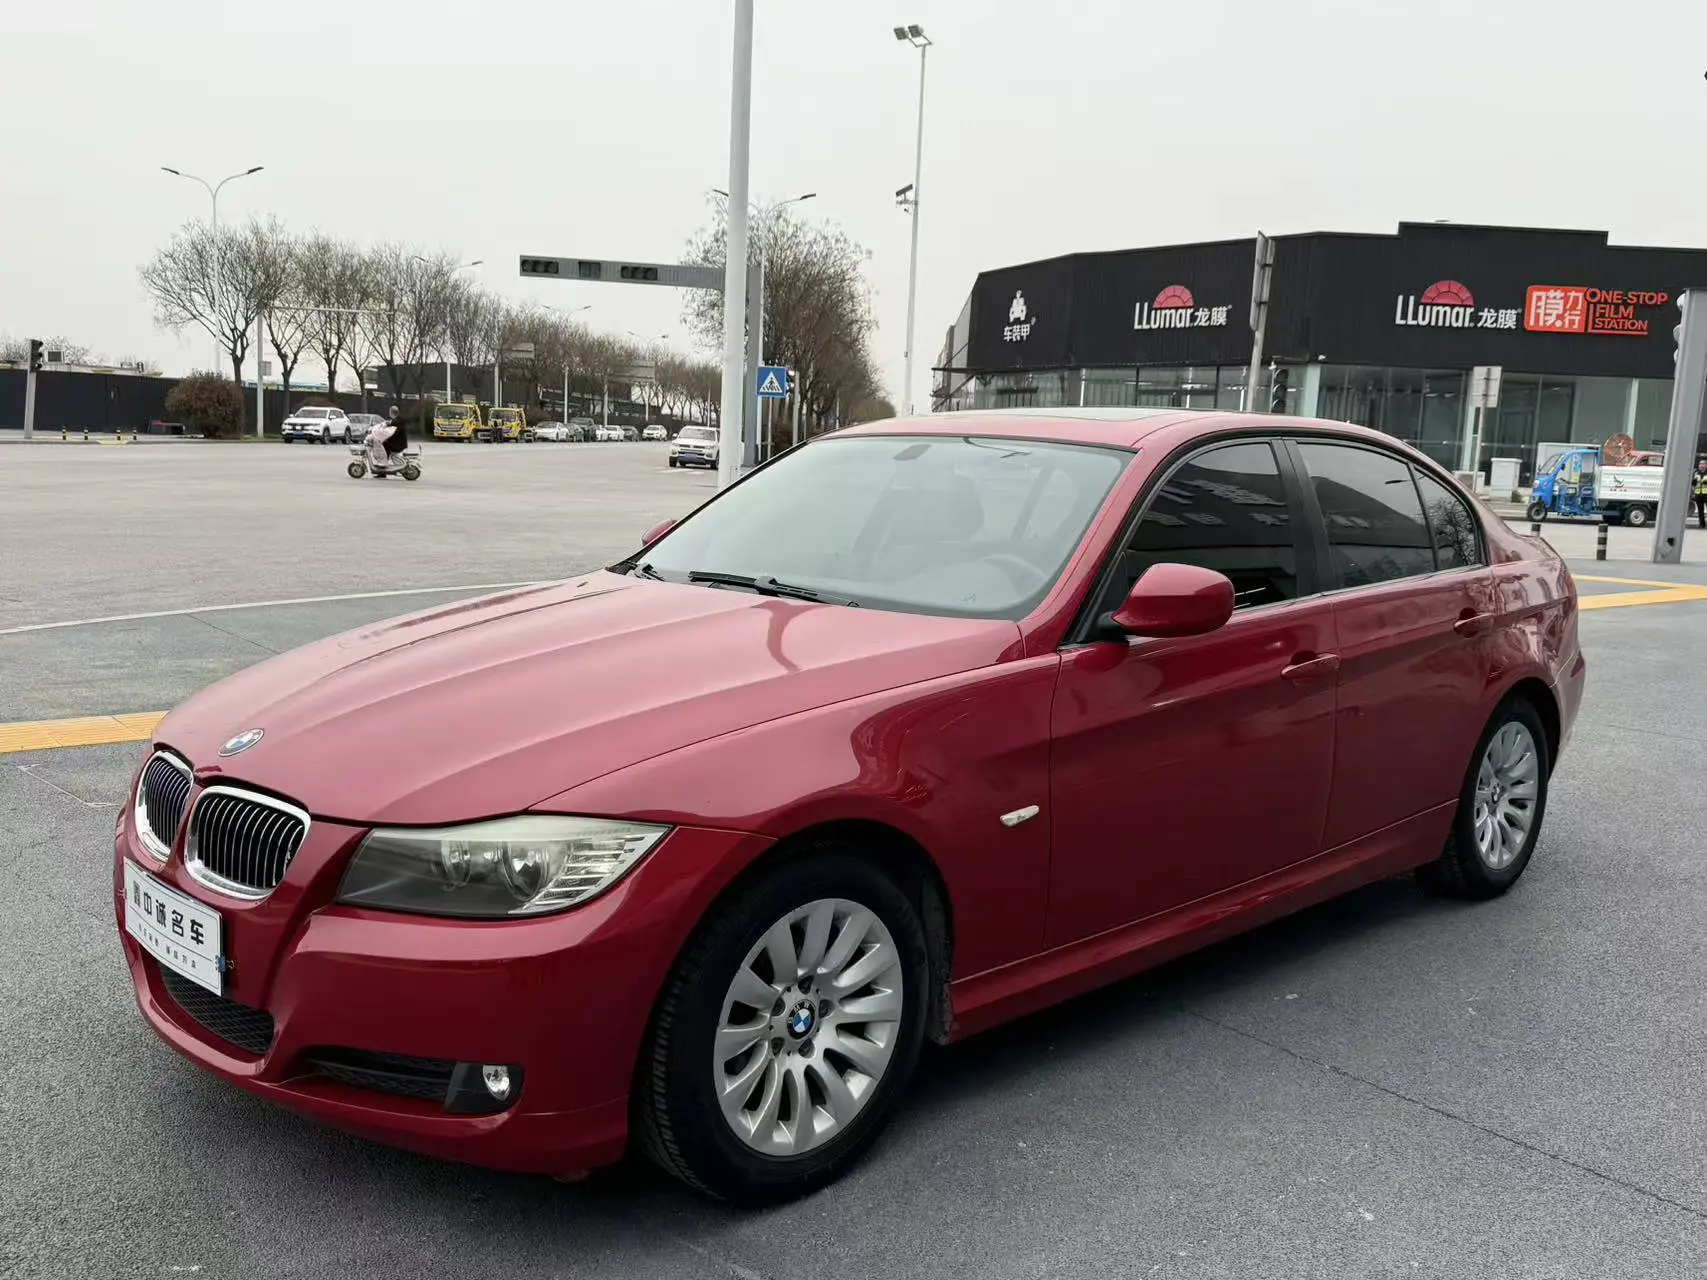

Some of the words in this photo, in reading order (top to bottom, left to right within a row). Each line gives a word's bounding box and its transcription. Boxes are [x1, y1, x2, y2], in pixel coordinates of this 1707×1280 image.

[1585, 288, 1668, 305] ONE-STOP
[1134, 302, 1193, 330] LLumar
[1194, 306, 1228, 327] 龙膜
[1395, 294, 1472, 327] LLumar
[1477, 307, 1518, 329] 龙膜
[1595, 304, 1634, 319] FILM
[1594, 318, 1648, 330] STATION
[1003, 325, 1030, 342] 车装甲
